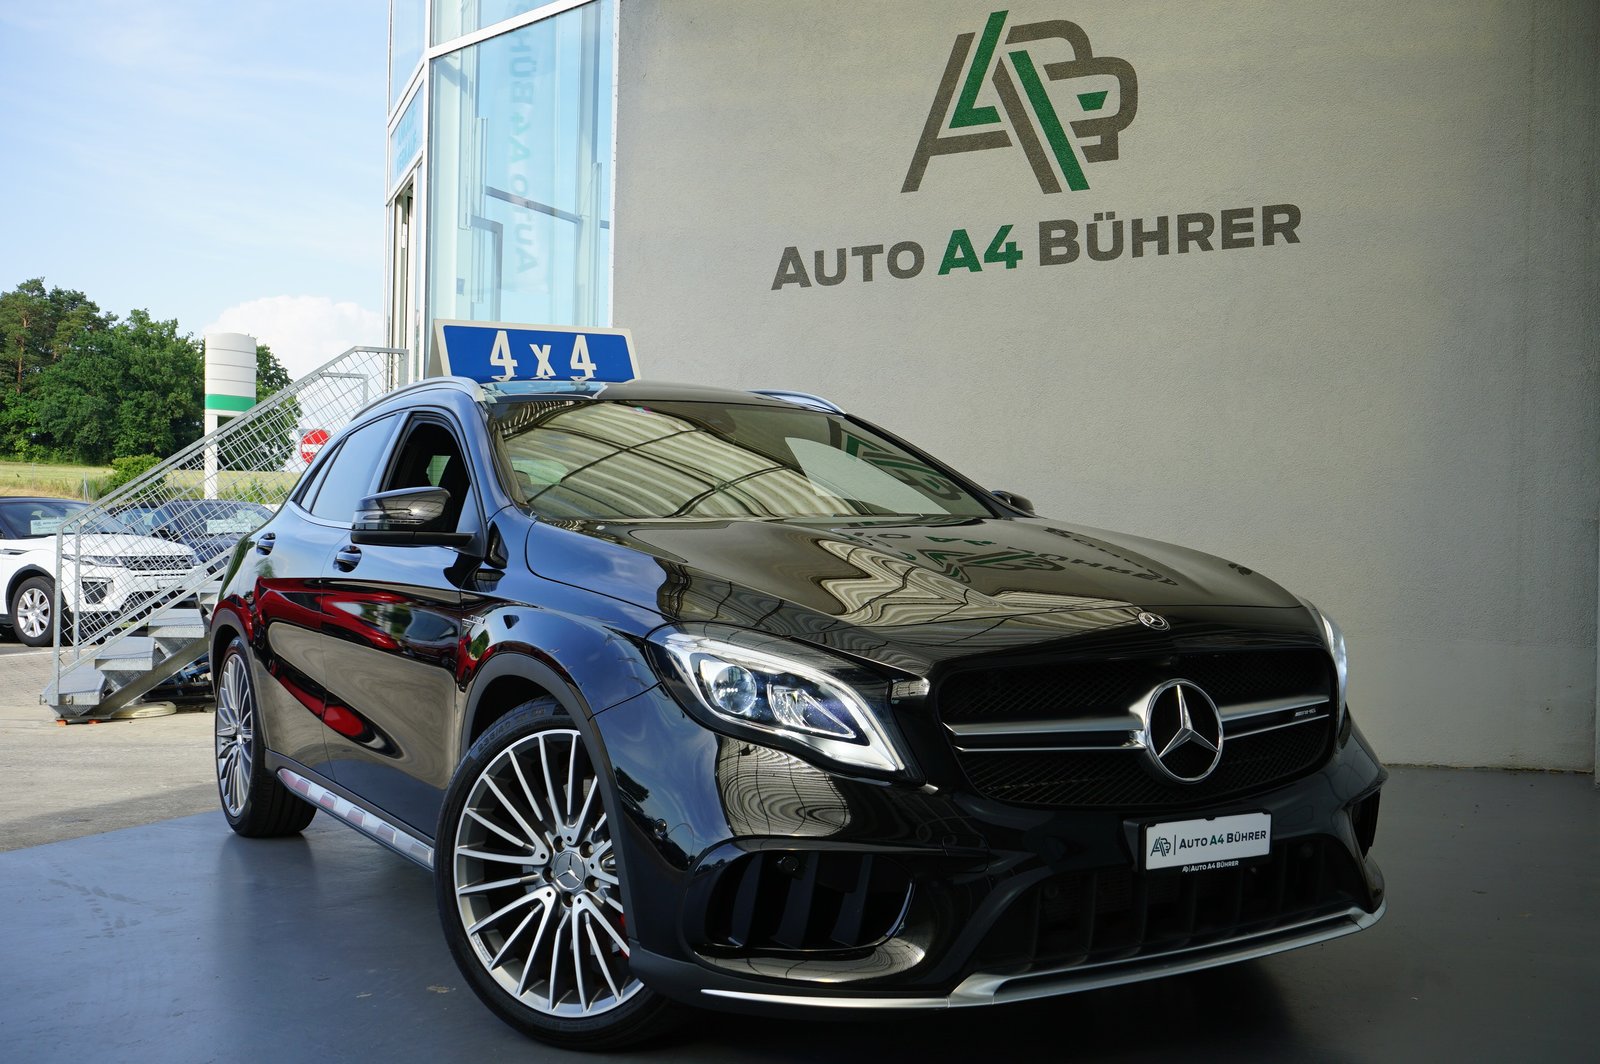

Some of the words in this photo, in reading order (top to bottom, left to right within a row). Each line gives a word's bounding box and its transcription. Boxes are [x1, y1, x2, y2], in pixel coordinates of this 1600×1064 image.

[770, 240, 926, 291] AUTO
[937, 223, 1024, 276] A4
[1038, 202, 1303, 267] BÜHRER
[489, 329, 519, 382] 4
[569, 334, 598, 382] 4
[1179, 837, 1208, 849] AUTO
[1209, 834, 1225, 846] A4
[1226, 830, 1267, 844] BÜHRER
[1190, 863, 1207, 872] AUTO
[1216, 860, 1239, 869] BÜHRER
